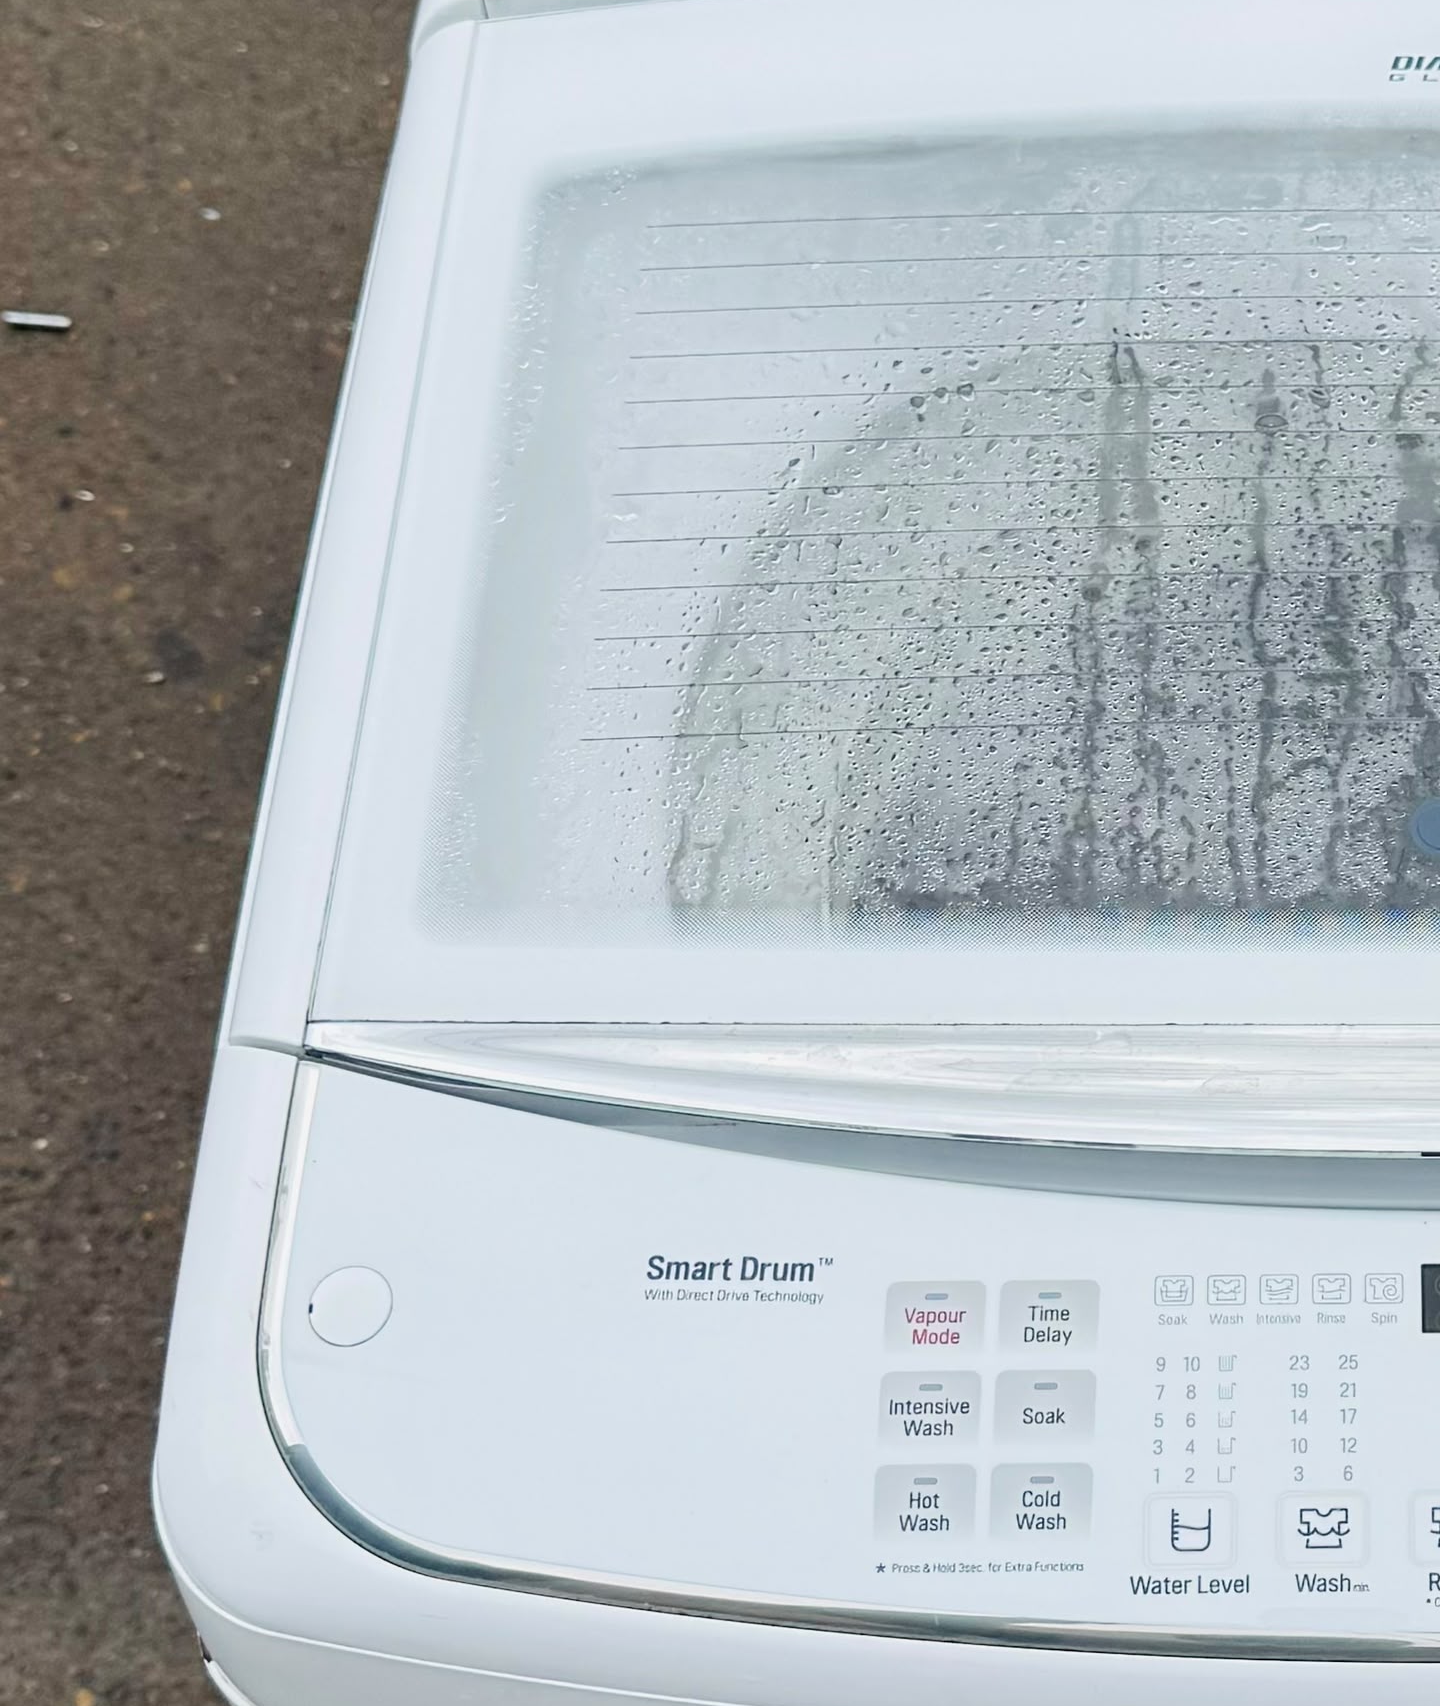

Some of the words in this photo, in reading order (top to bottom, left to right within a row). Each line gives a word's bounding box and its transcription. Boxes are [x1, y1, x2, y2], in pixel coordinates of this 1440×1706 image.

[647, 1255, 733, 1281] Smart
[644, 1289, 674, 1301] With
[676, 1289, 714, 1302] Direct
[717, 1289, 750, 1302] Drive
[754, 1290, 824, 1305] Technology
[904, 1307, 967, 1327] Vapour
[1027, 1305, 1070, 1321] Time
[1158, 1313, 1188, 1326] Soak
[1209, 1313, 1244, 1325] Wash
[1256, 1313, 1301, 1325] Intensive
[1317, 1312, 1346, 1324] Rinse
[1371, 1312, 1398, 1326] Spin
[911, 1328, 961, 1345] Mode
[1023, 1326, 1073, 1346] Delay
[1155, 1356, 1166, 1372] 9
[1183, 1356, 1201, 1372] 10
[1289, 1355, 1310, 1371] 23
[1338, 1354, 1359, 1370] 25
[1155, 1384, 1165, 1400] 7
[1185, 1384, 1197, 1400] 8
[1290, 1383, 1308, 1398] 19
[1339, 1382, 1357, 1398] 21
[889, 1398, 970, 1416] Intensive
[1022, 1407, 1066, 1425] Soak
[1153, 1413, 1164, 1428] 5
[1185, 1412, 1196, 1428] 6
[1290, 1409, 1308, 1424] 14
[1339, 1408, 1357, 1424] 17
[903, 1420, 954, 1437] Wash
[1152, 1439, 1163, 1455] 3
[1185, 1439, 1196, 1454] 4
[1290, 1438, 1308, 1454] 10
[1339, 1437, 1358, 1453] 12
[1153, 1468, 1160, 1484] 1
[1184, 1467, 1195, 1483] 2
[1293, 1466, 1304, 1482] 3
[1342, 1465, 1353, 1481] 6
[908, 1492, 940, 1509] Hot
[1022, 1490, 1061, 1508] Cold
[899, 1514, 950, 1532] Wash
[1016, 1513, 1067, 1530] Wash
[933, 1563, 956, 1574] Hold
[988, 1562, 1001, 1573] for
[1005, 1562, 1032, 1572] Extra
[1034, 1561, 1084, 1573] Functions
[1130, 1575, 1192, 1595] Water
[1197, 1574, 1250, 1594] Level
[1295, 1573, 1351, 1592] Wash
